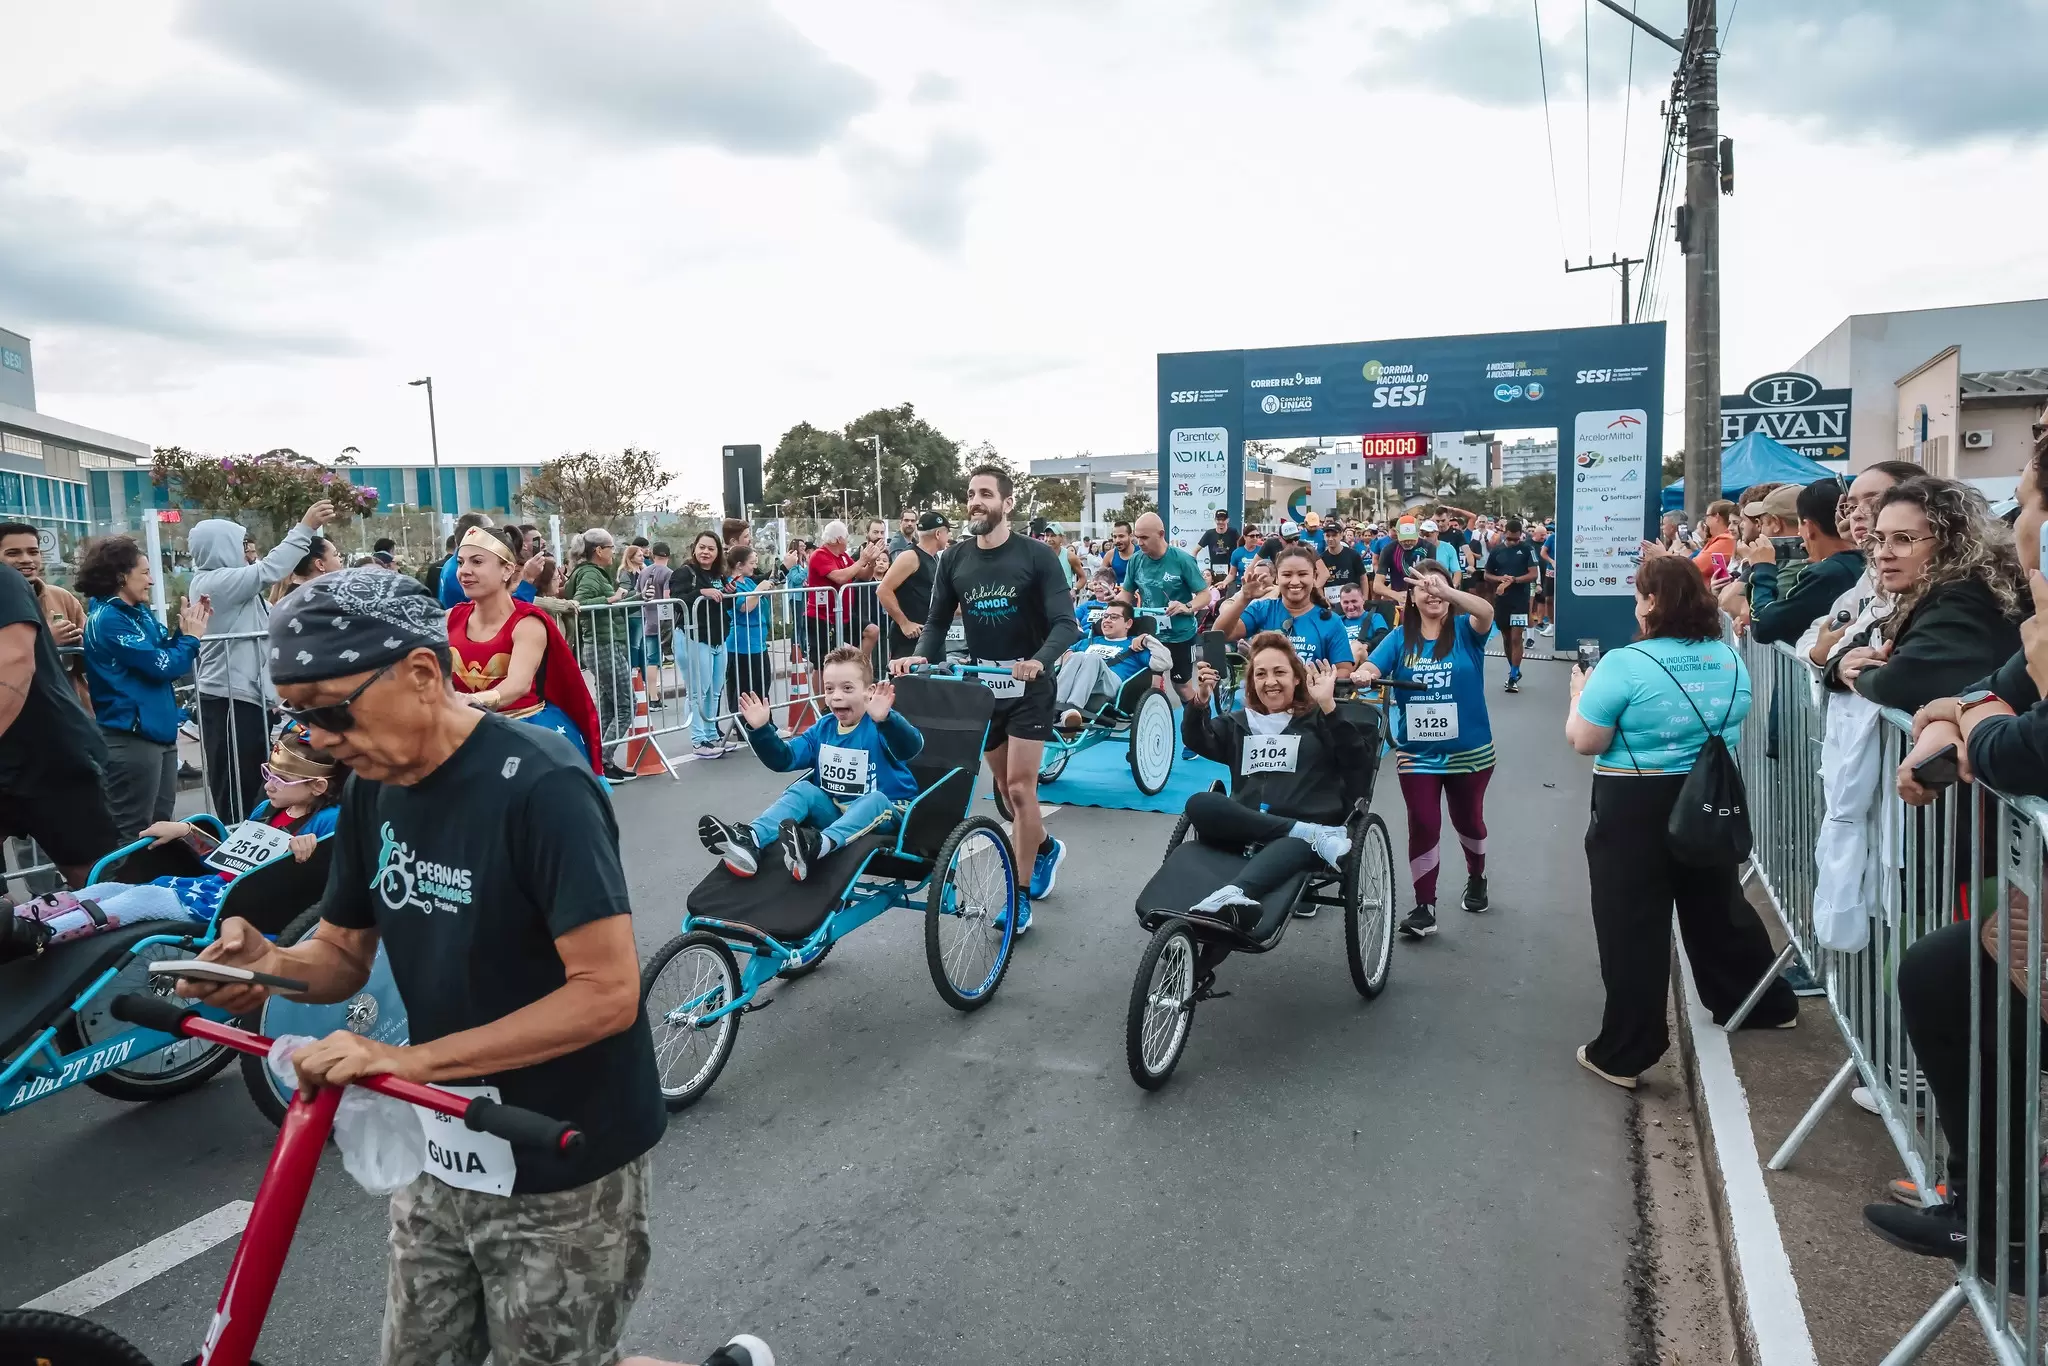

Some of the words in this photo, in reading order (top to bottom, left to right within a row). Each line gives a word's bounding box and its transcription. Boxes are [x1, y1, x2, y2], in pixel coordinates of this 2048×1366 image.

[1378, 364, 1413, 374] CORRIDA
[1250, 378, 1280, 388] CORRER
[1281, 378, 1294, 387] FAZ
[1305, 376, 1322, 385] BEM
[1377, 375, 1415, 385] NACIONAL
[1416, 374, 1429, 383] DO
[1771, 380, 1796, 403] H
[1721, 410, 1846, 441] HAVAN
[1177, 431, 1220, 442] Parentex
[1579, 432, 1634, 442] ArcelorMittal
[1202, 486, 1221, 494] FGM
[1443, 662, 1453, 670] DO
[988, 680, 1015, 689] GUIA
[1414, 718, 1448, 729] 3128
[1250, 747, 1287, 760] 3104
[1250, 761, 1287, 769] ANGELITA
[823, 764, 857, 781] 2505
[827, 782, 846, 792] THEO
[230, 839, 271, 863] 2510
[9, 1056, 89, 1107] ADAPT
[87, 1037, 136, 1075] RUN
[428, 1140, 487, 1174] GUIA
